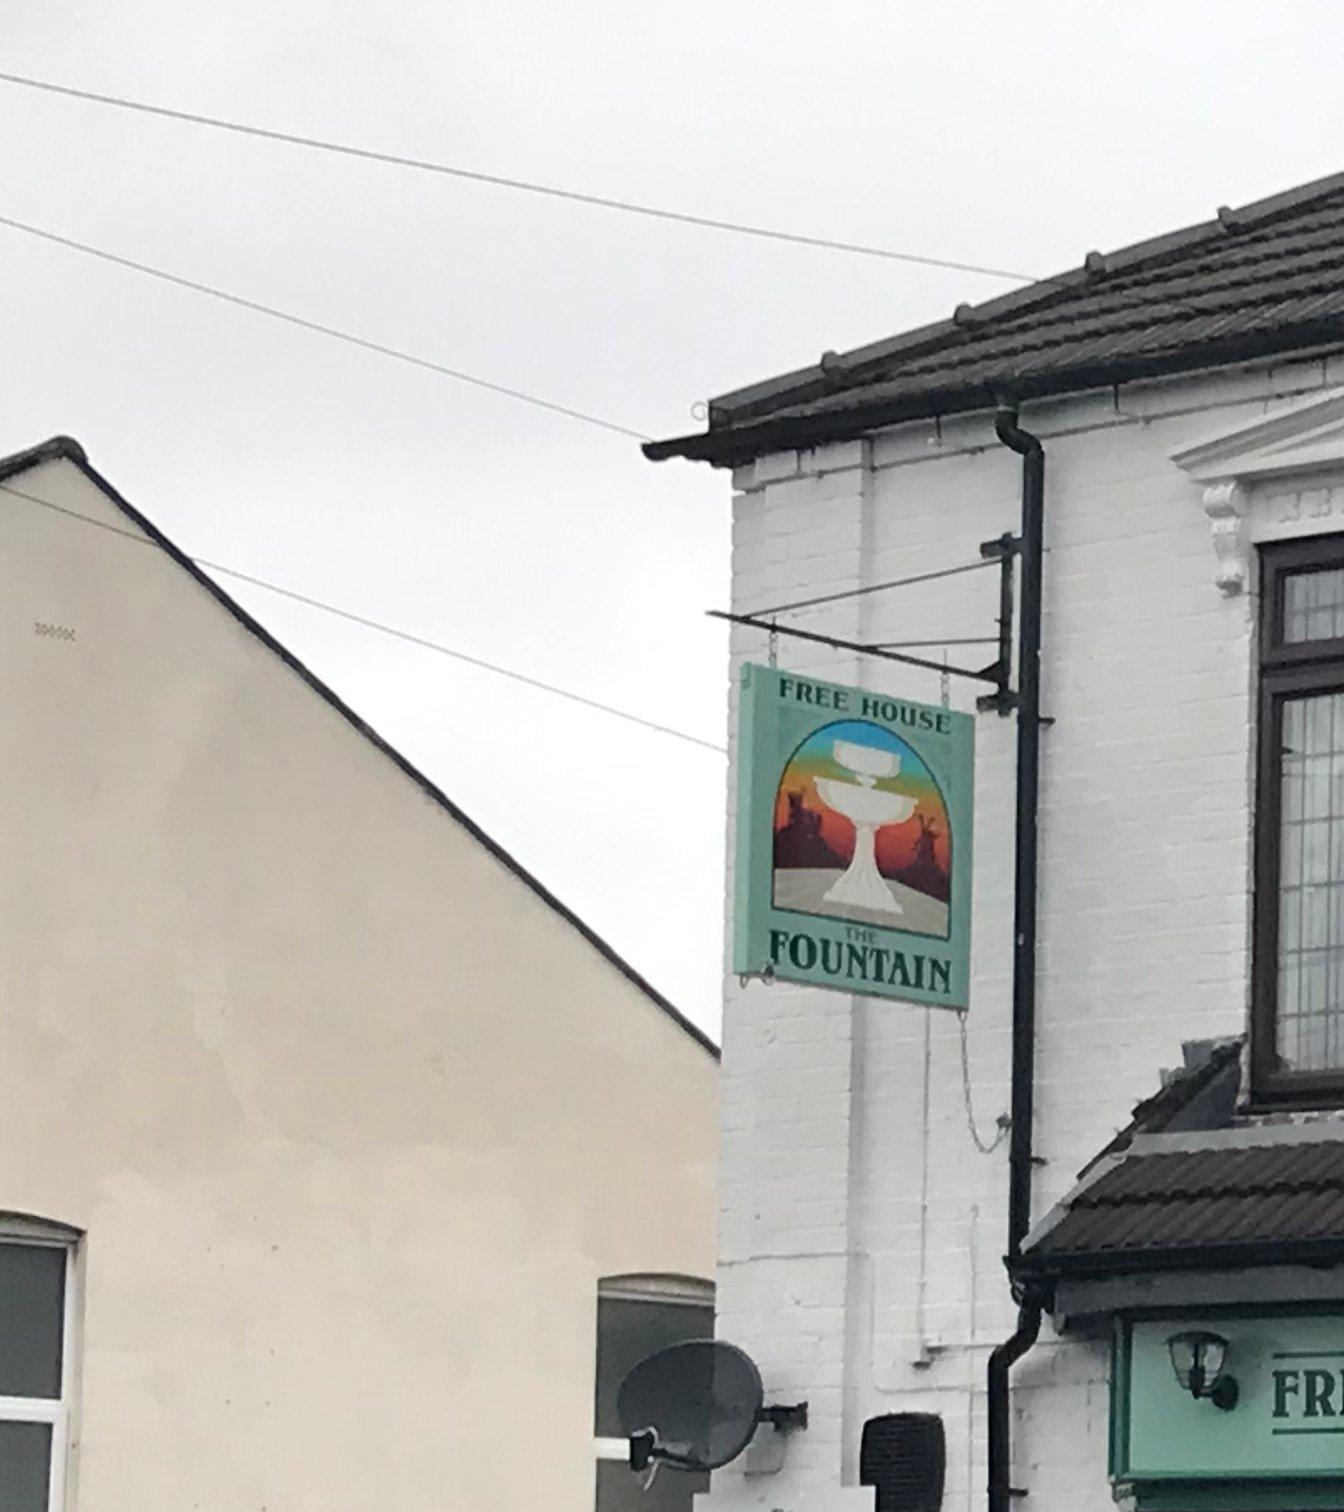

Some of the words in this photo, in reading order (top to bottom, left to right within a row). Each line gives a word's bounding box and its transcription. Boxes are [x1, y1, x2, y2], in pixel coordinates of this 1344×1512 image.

[779, 676, 848, 713] FREE
[860, 697, 952, 736] HOUSE
[768, 929, 953, 994] FOUNTAIN
[844, 926, 877, 945] THE
